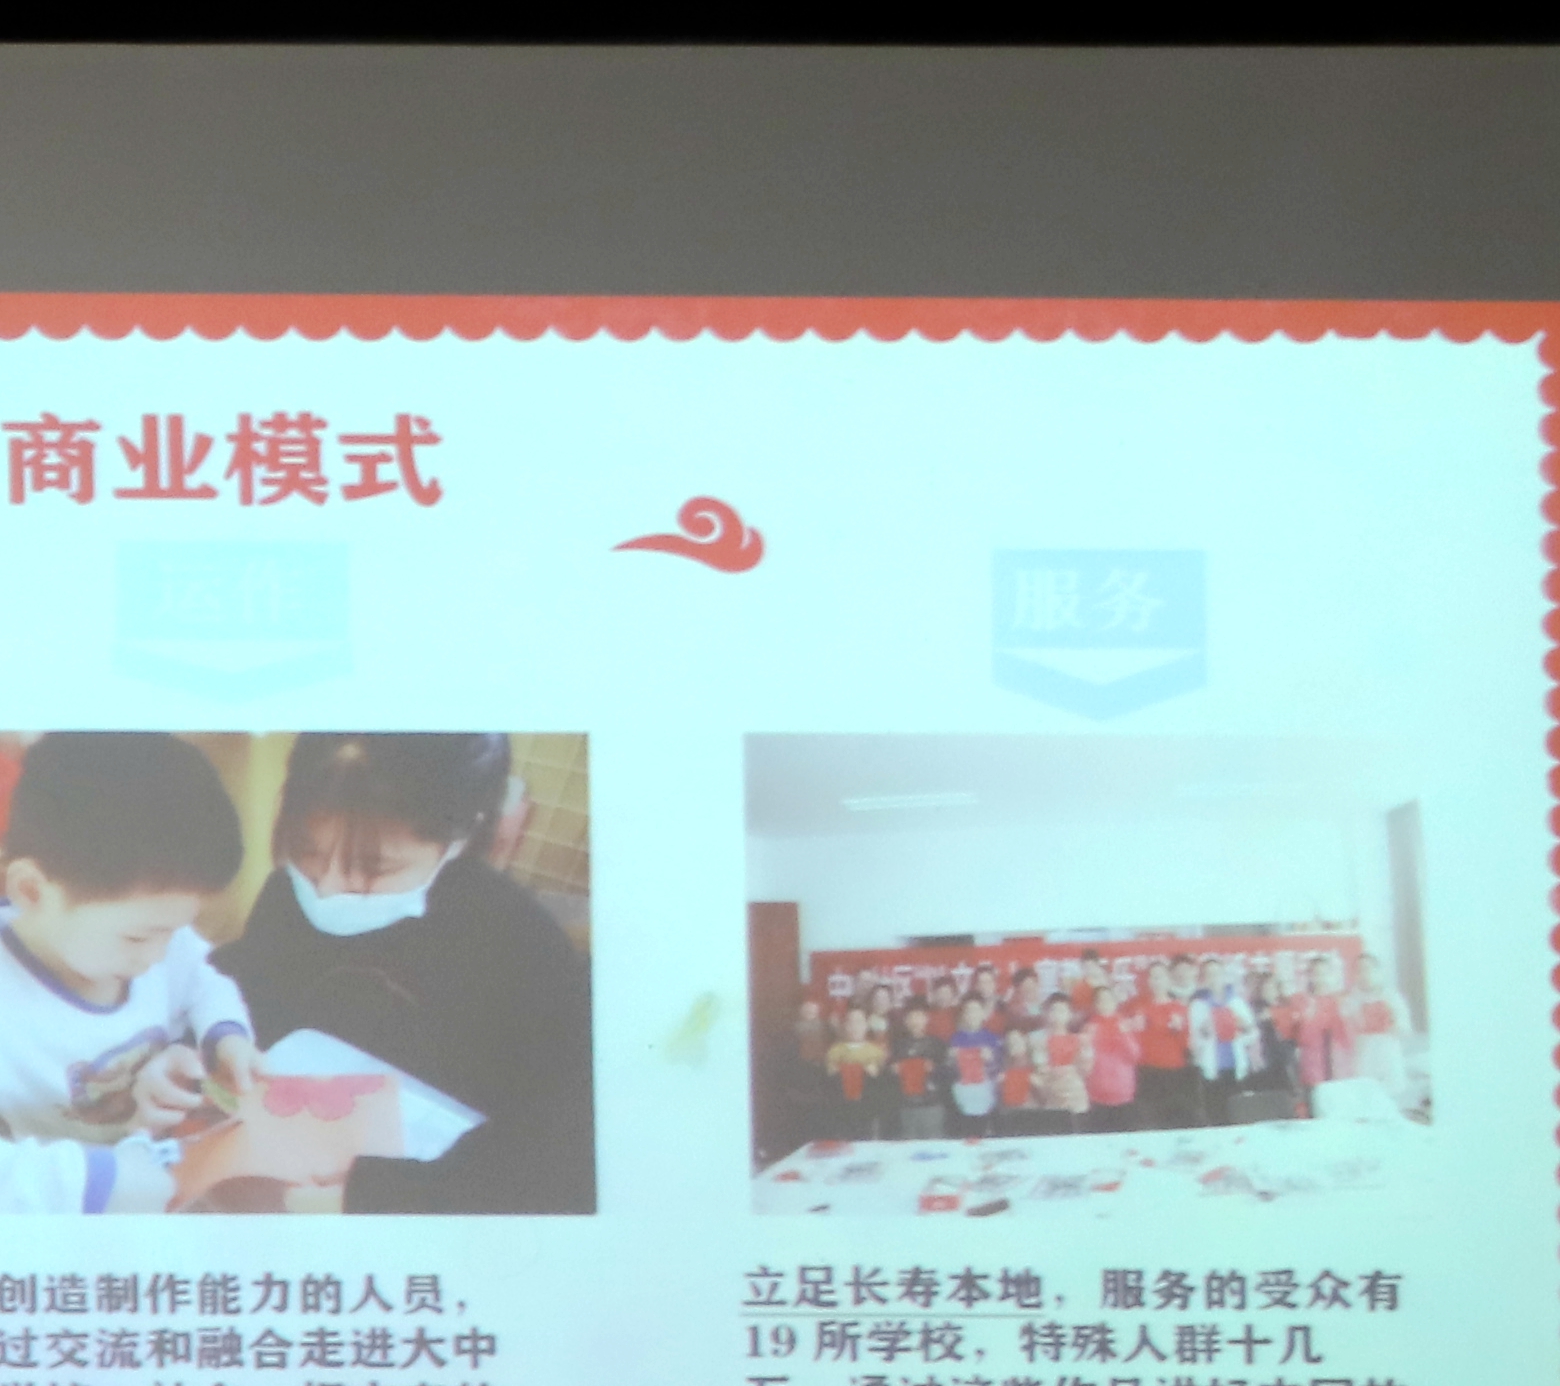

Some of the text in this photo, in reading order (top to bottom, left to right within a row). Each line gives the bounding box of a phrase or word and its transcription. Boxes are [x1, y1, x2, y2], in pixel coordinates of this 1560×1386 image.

[1, 411, 443, 506] 商业模式
[1012, 568, 1167, 632] 服务
